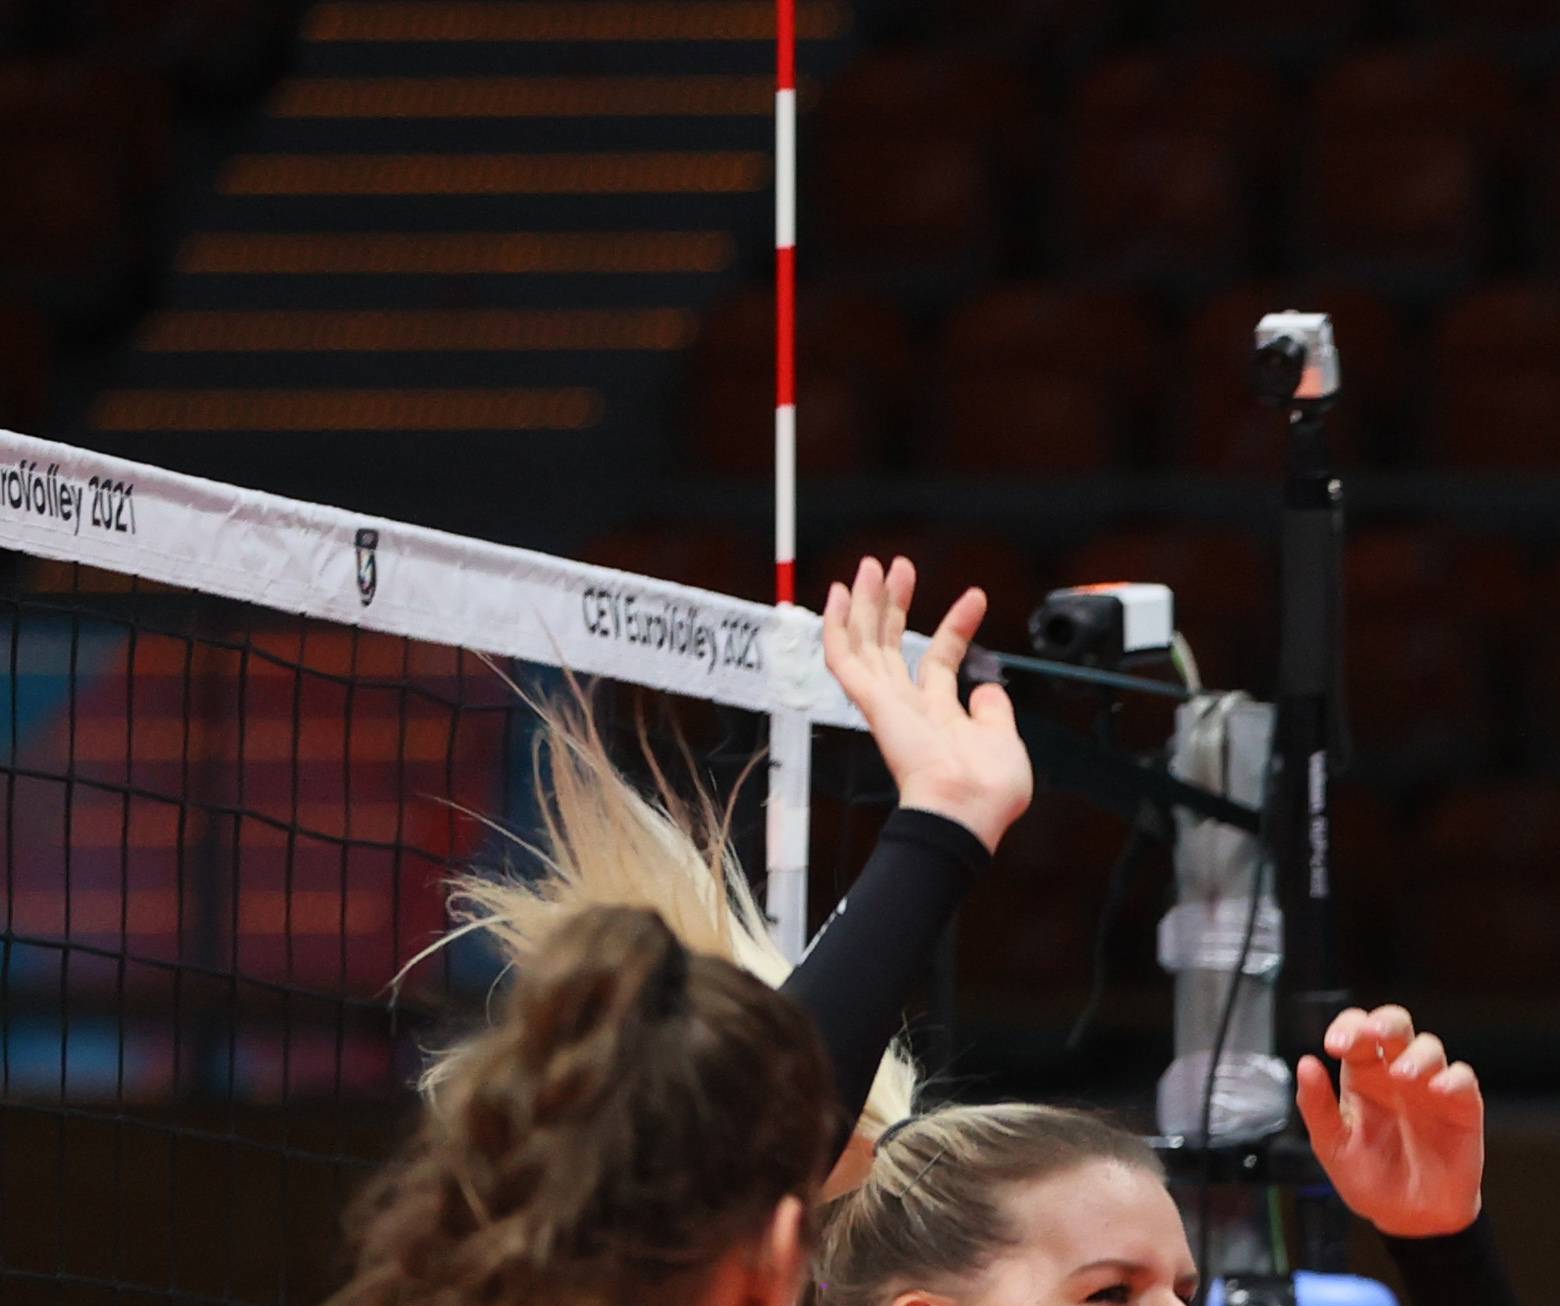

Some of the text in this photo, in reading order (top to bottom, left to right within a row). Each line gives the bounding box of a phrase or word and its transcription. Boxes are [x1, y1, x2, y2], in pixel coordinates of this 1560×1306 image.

[88, 475, 136, 535] 2021
[582, 586, 622, 640] CEV
[624, 596, 717, 675] EuroVolley
